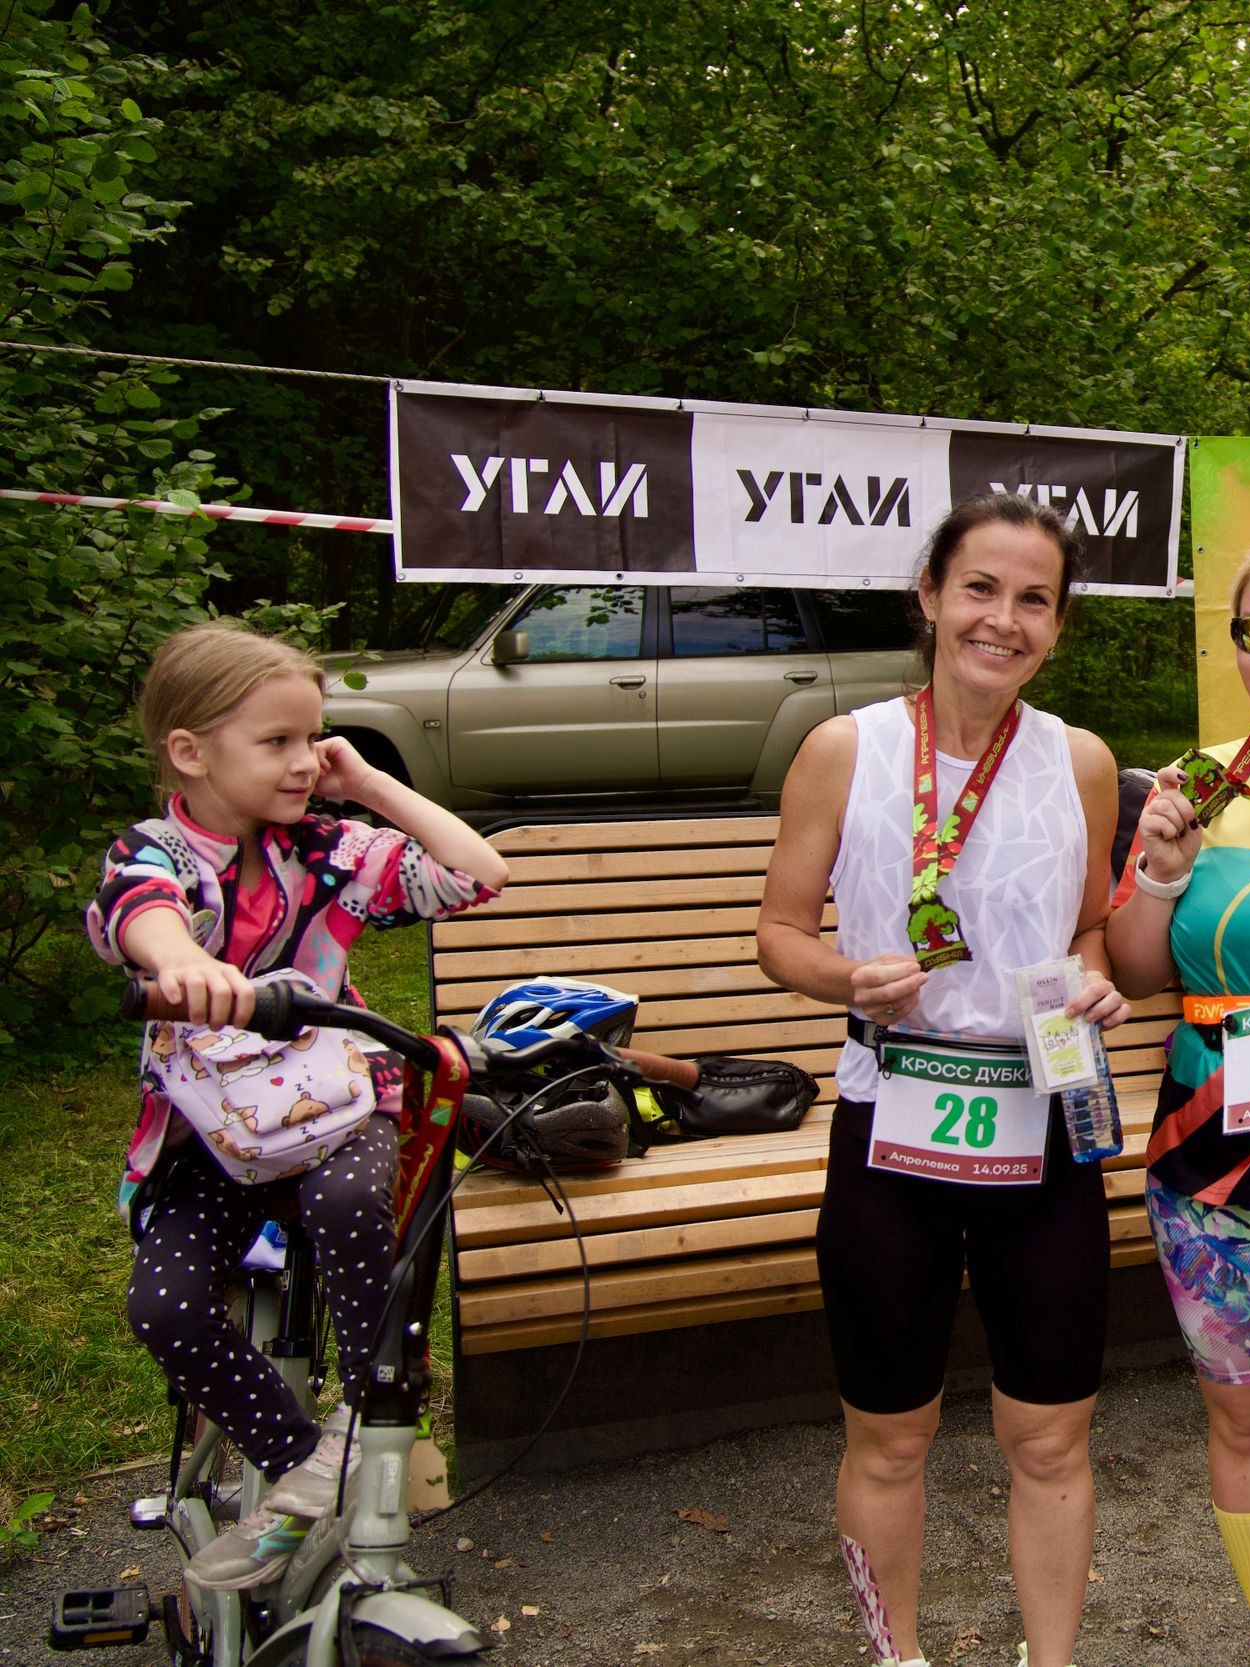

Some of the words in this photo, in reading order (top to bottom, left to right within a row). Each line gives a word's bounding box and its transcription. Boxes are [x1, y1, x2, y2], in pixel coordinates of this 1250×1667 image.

[450, 453, 649, 519] УГЛИ
[736, 468, 912, 528] УГЛИ
[901, 1055, 971, 1080] КРОСС
[930, 1092, 999, 1149] 28
[889, 1151, 960, 1172] Апрелевка
[972, 1163, 1028, 1176] 14.09.25
